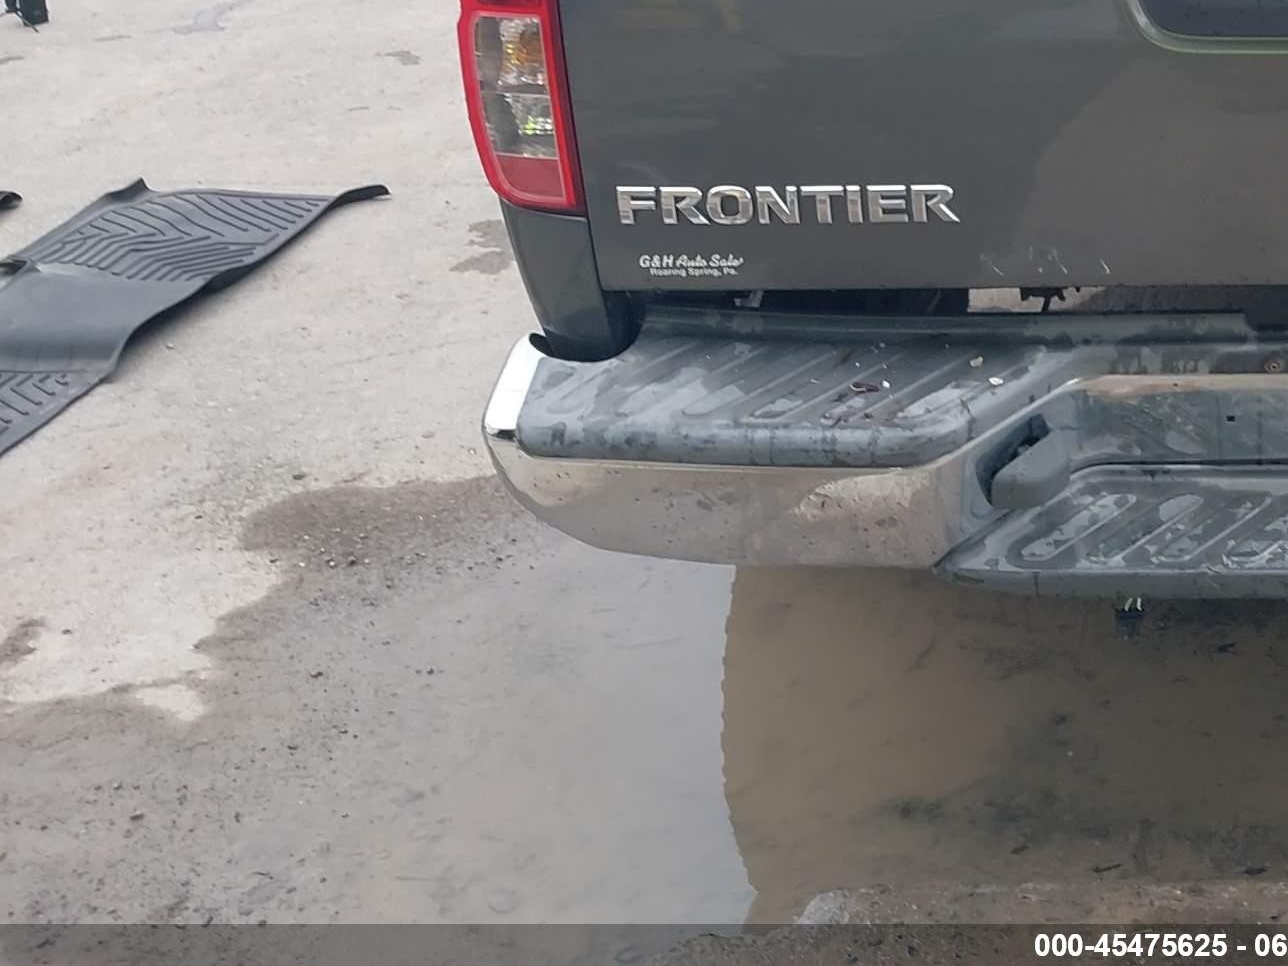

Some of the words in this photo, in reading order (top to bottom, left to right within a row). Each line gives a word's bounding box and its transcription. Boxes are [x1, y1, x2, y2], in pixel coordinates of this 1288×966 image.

[615, 184, 961, 226] FRONTIER
[639, 254, 674, 268] G&H
[675, 254, 708, 268] Auto
[649, 267, 687, 277] Roaring
